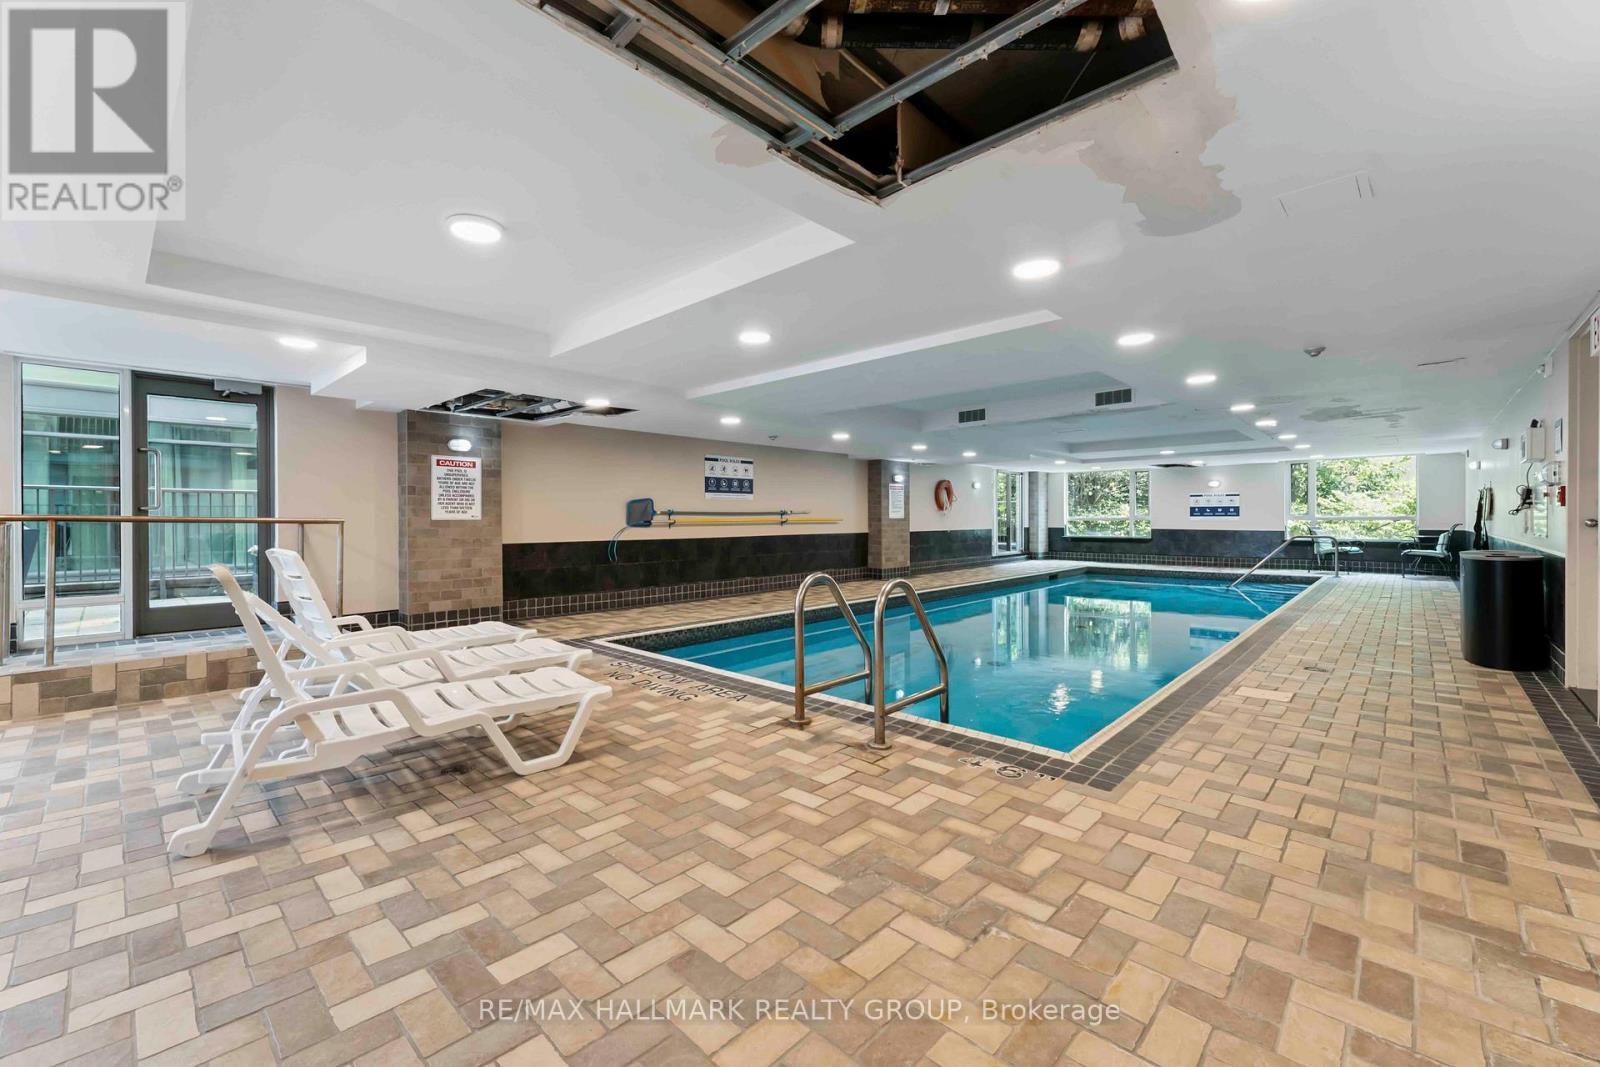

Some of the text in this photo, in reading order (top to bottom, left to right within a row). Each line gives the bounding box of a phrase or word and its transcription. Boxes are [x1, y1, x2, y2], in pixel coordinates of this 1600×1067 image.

[604, 671, 698, 701] NO DIVING
[690, 684, 748, 702] AREA
